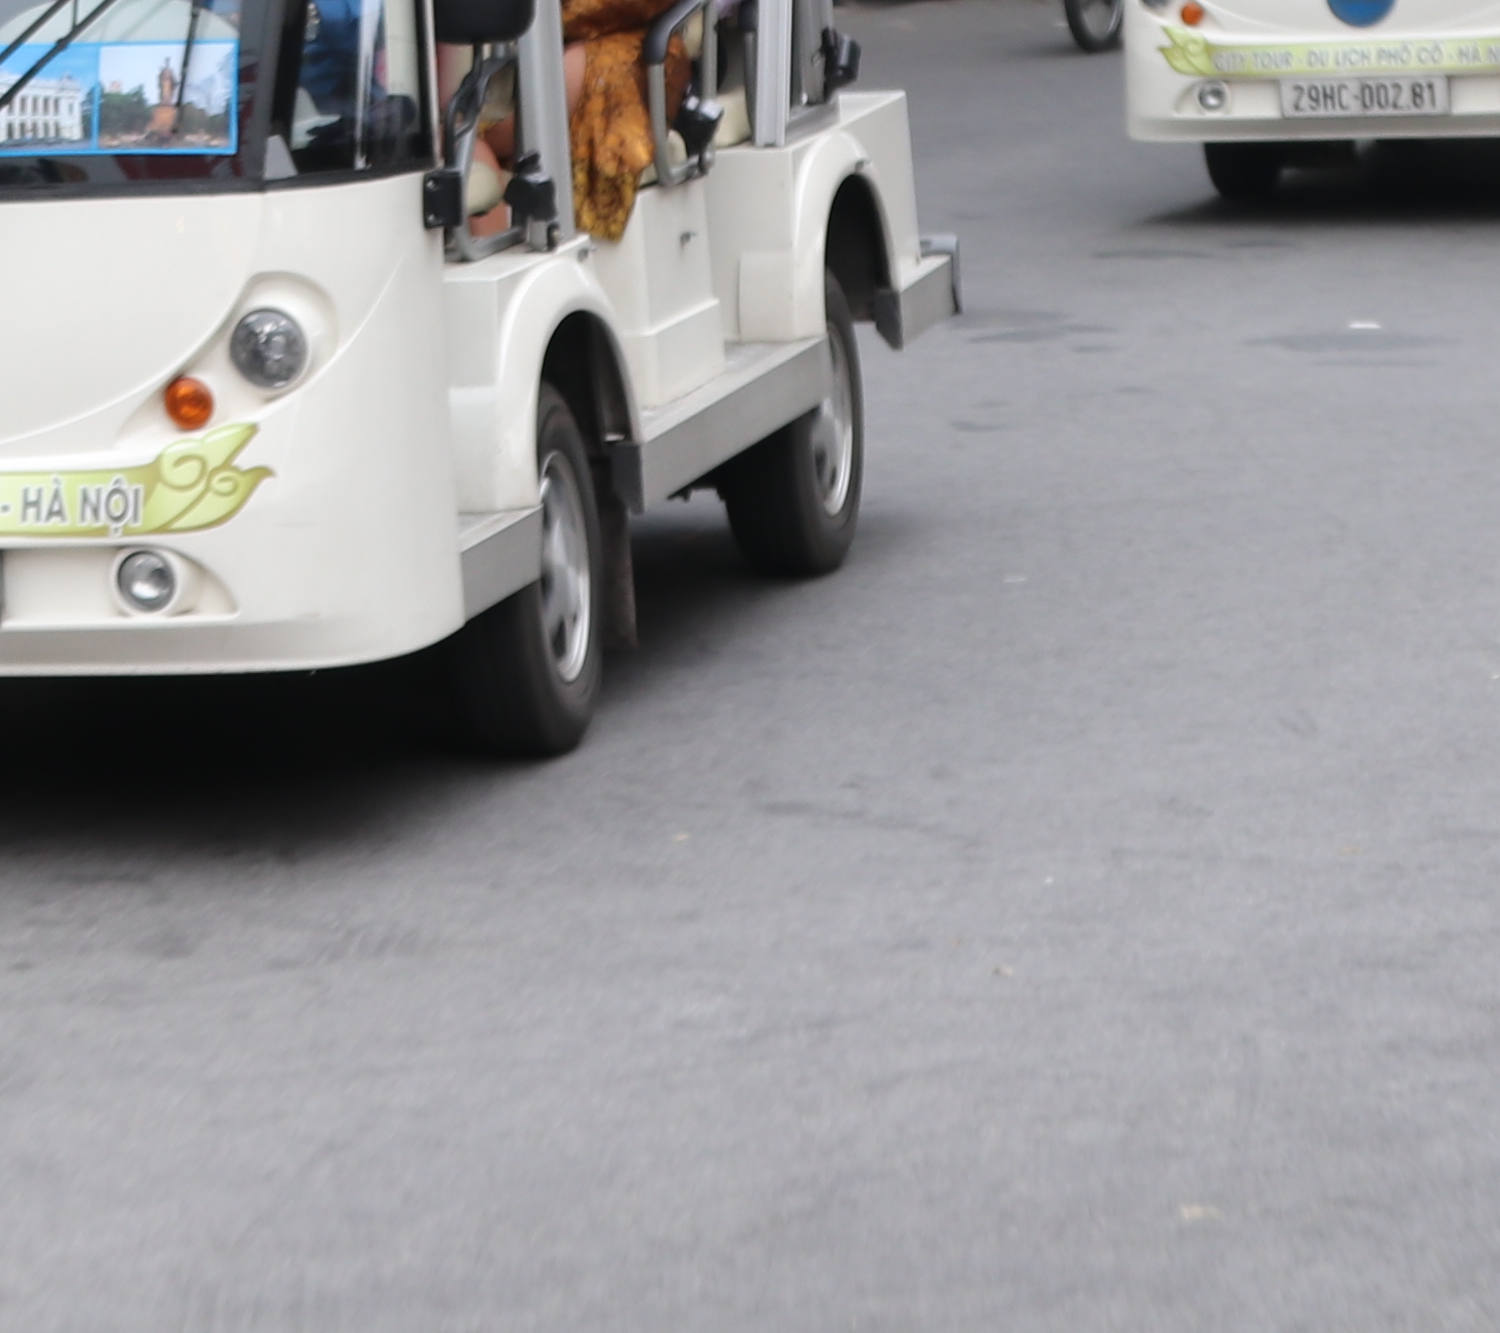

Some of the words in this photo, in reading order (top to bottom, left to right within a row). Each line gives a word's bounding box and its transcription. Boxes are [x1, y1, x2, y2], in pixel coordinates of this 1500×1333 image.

[1252, 49, 1294, 69] TOUR
[1307, 48, 1330, 68] DU
[1458, 40, 1482, 65] HÀ
[20, 476, 70, 525] HÀ
[78, 475, 143, 537] NỘI
